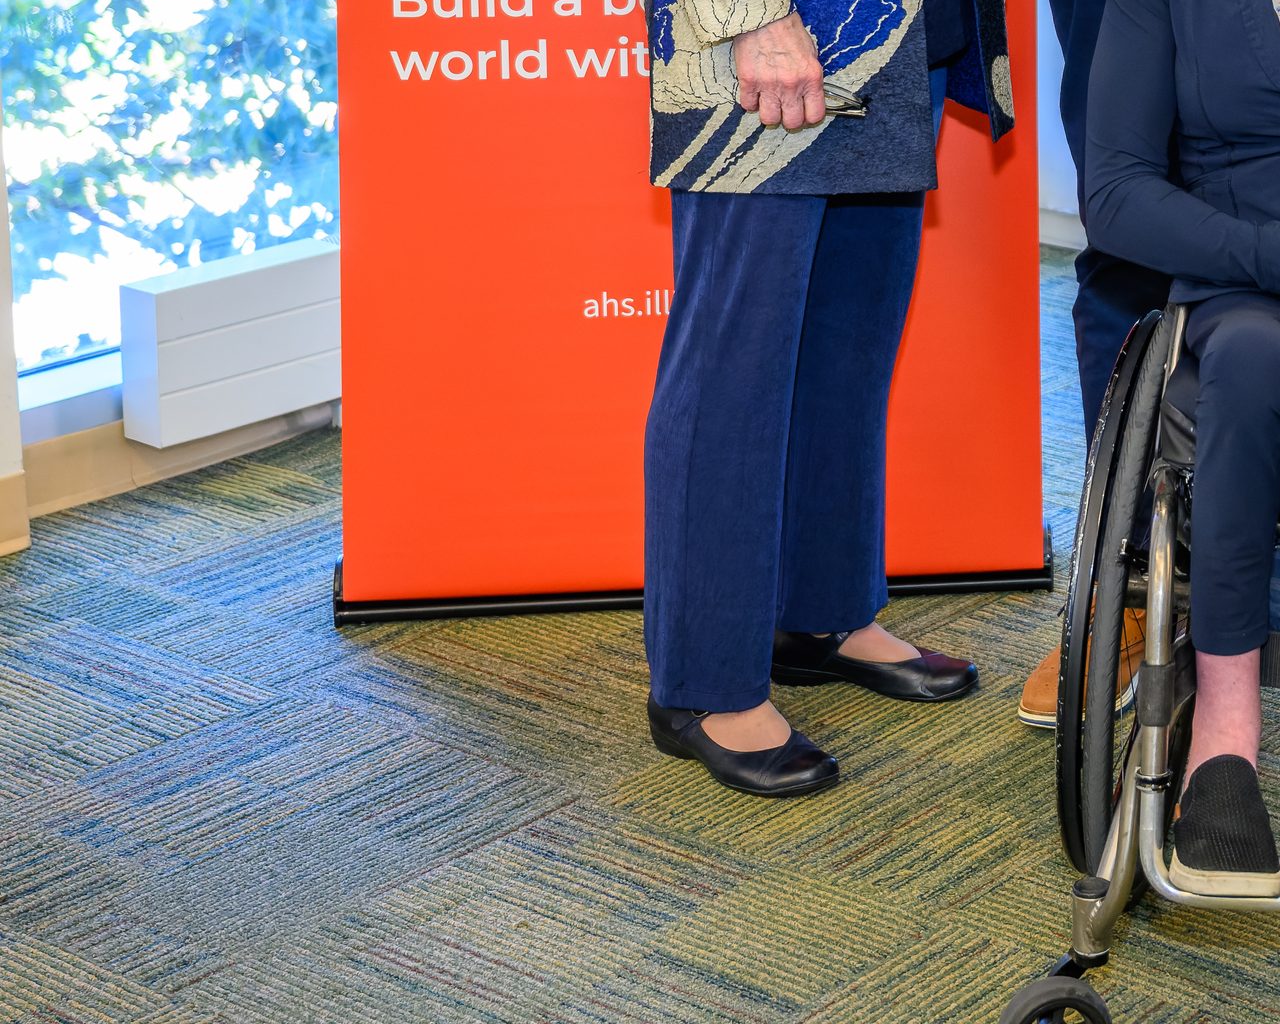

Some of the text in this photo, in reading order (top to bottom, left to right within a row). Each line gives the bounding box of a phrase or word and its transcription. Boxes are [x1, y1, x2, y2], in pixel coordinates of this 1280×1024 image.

[390, 35, 650, 81] world wit
[583, 289, 675, 318] ahs.ill
